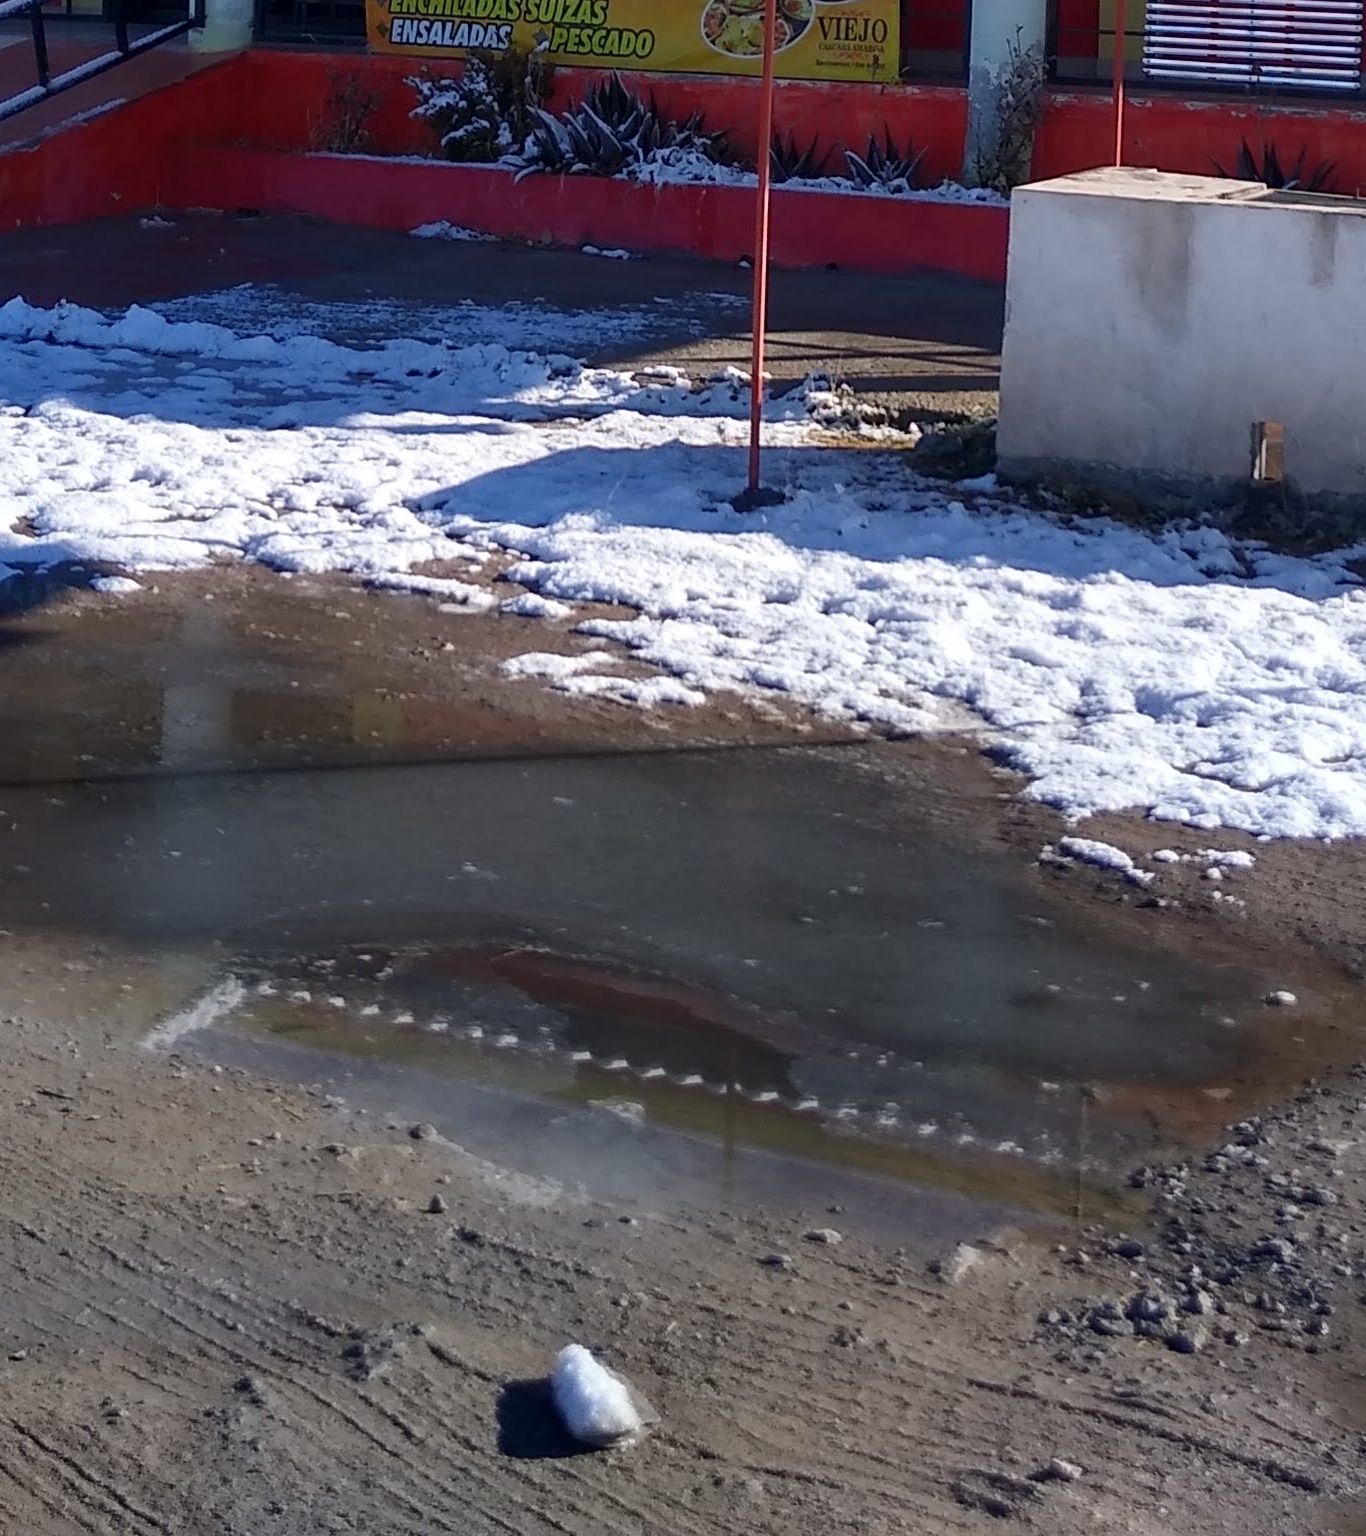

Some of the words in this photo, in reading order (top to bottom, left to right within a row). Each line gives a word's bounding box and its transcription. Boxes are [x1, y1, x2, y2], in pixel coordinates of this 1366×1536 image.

[390, 18, 515, 51] ENSALADAS
[549, 26, 655, 59] PESCADO
[816, 16, 889, 44] VIEJO
